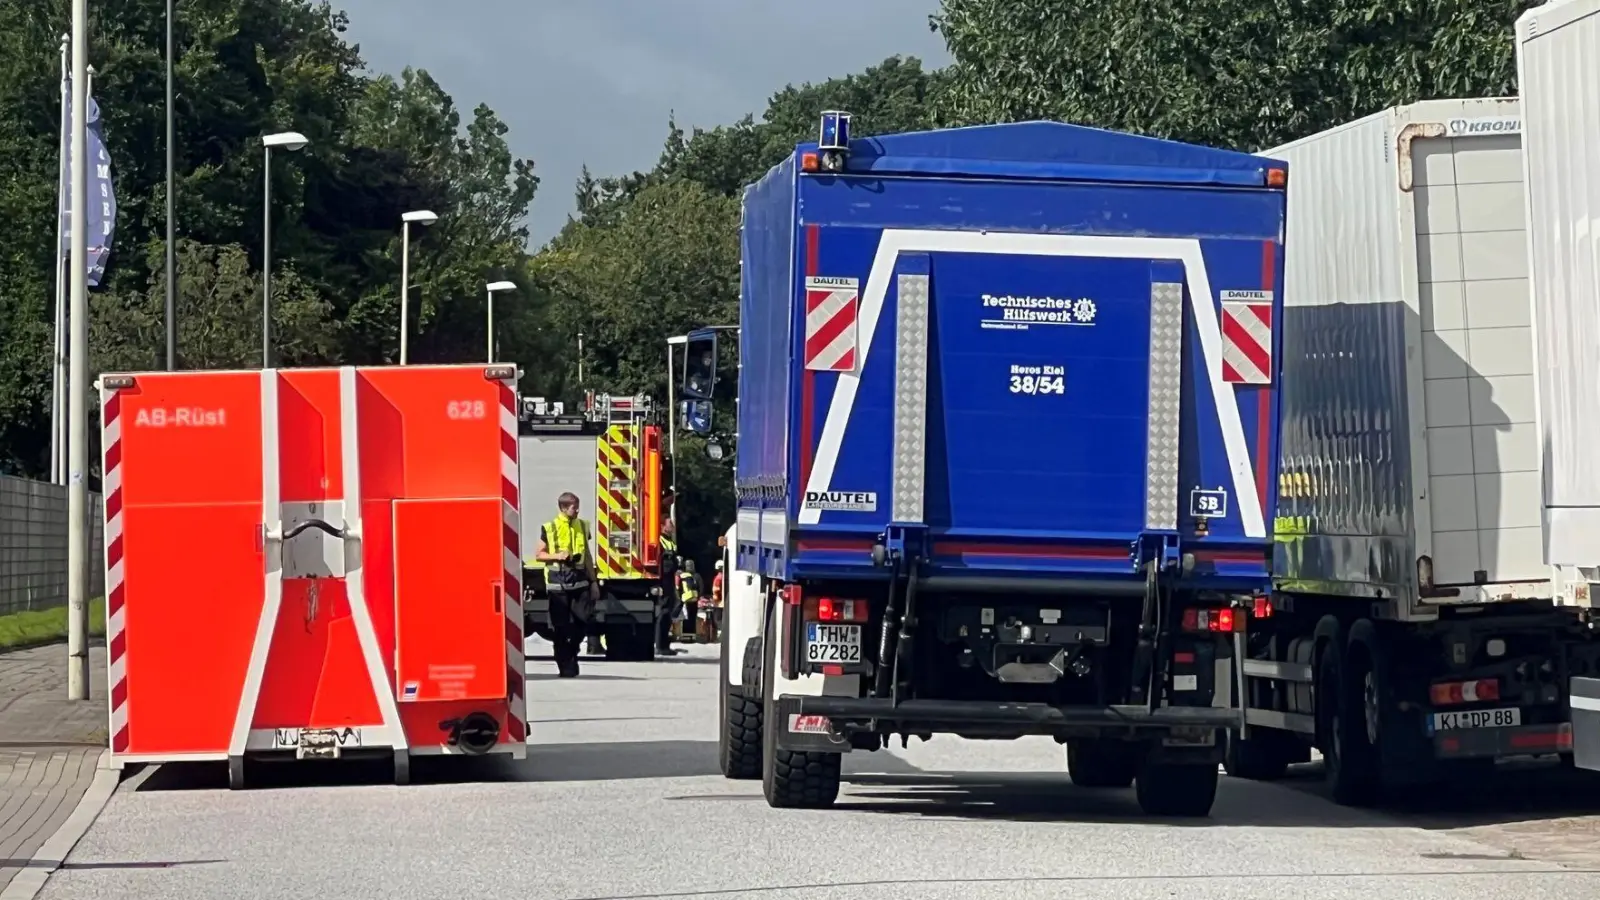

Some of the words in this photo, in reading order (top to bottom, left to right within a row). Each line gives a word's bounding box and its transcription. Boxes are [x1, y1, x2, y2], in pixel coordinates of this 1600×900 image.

[1469, 120, 1522, 132] KRON
[813, 277, 851, 286] DAUTEL
[981, 294, 1072, 309] Technisches
[1228, 291, 1265, 299] DAUTEL
[1003, 308, 1072, 322] Hilfswerk
[1010, 364, 1041, 375] Heros
[1043, 365, 1065, 376] Kiel
[1009, 375, 1065, 396] 38/54
[134, 406, 226, 428] AB-Rüst
[446, 400, 486, 420] 628
[806, 491, 875, 504] DAUTEL
[1198, 495, 1219, 510] SB
[817, 626, 850, 643] THW
[809, 644, 859, 661] 87282
[1441, 713, 1461, 731] KI
[1470, 711, 1491, 728] DP
[1494, 710, 1513, 726] 88
